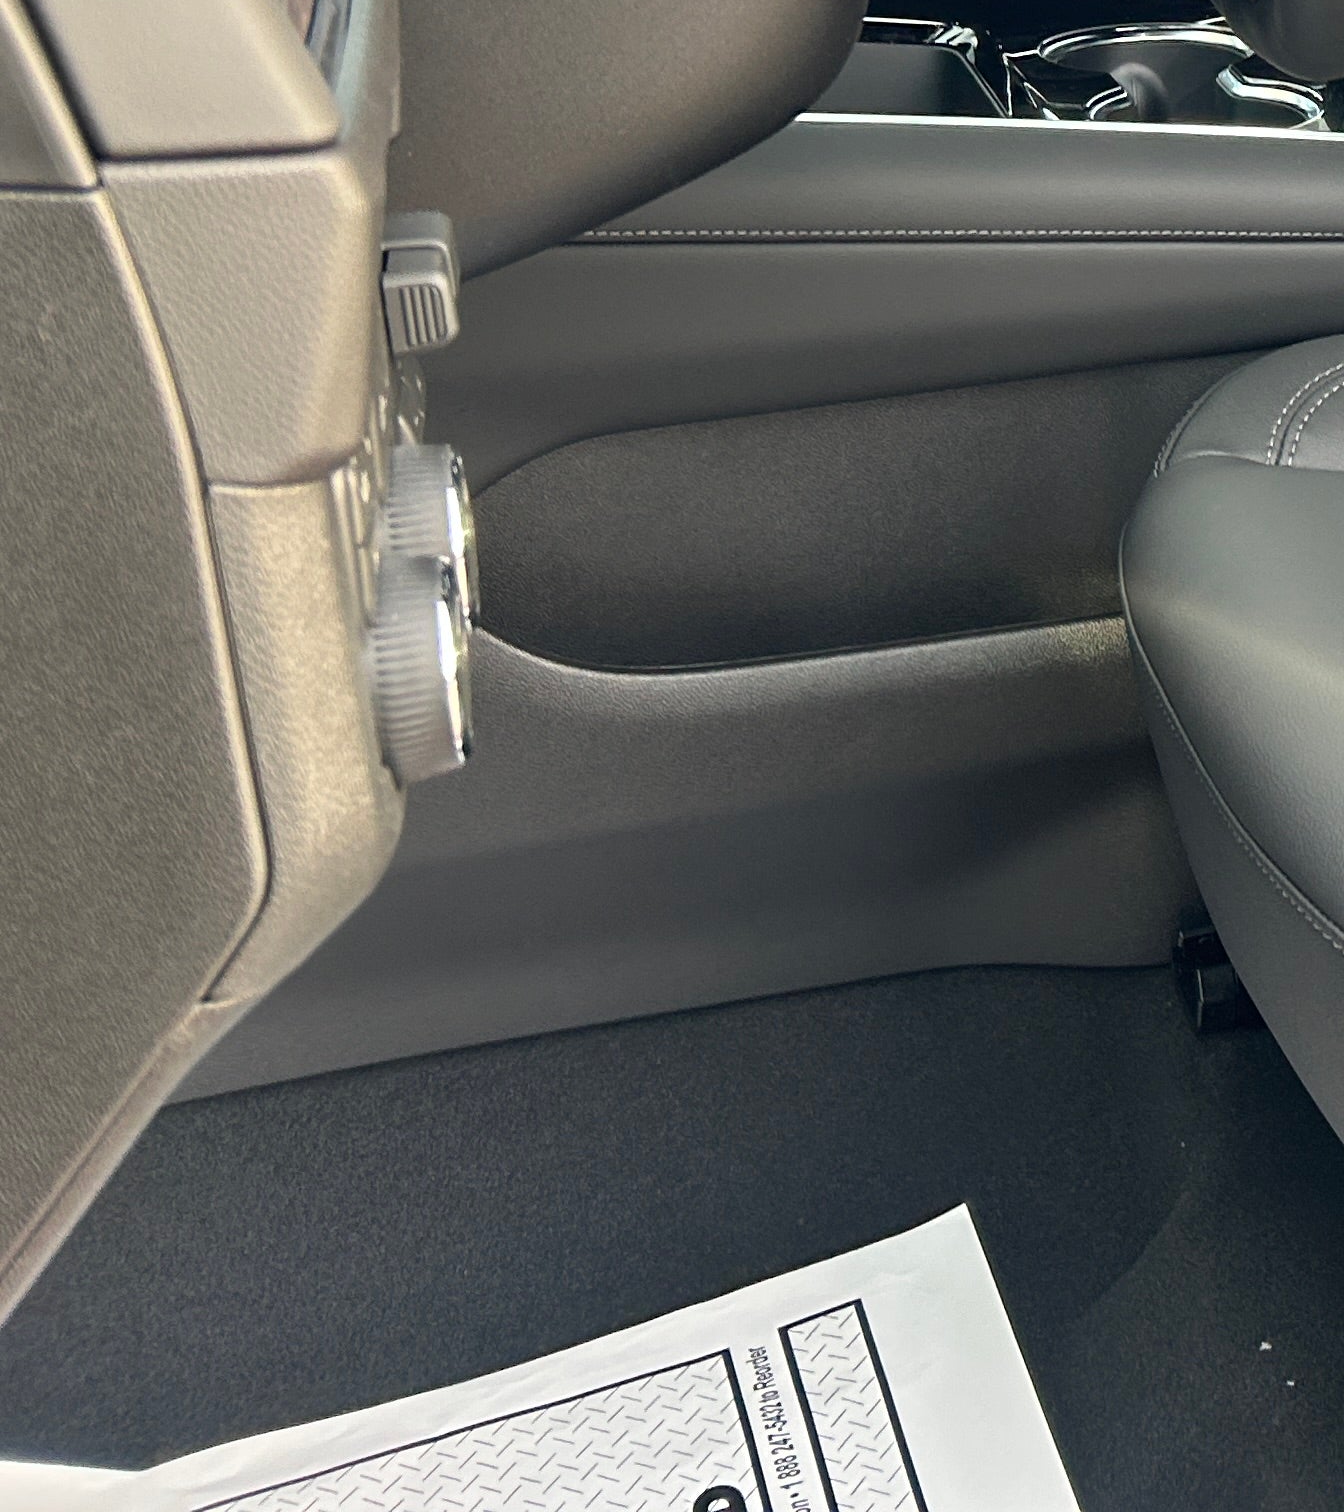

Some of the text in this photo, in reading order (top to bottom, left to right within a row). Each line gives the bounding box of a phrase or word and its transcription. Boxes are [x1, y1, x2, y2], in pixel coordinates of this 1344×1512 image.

[746, 1346, 776, 1391] Reorder
[759, 1390, 780, 1403] to
[759, 1402, 796, 1455] 247-5432
[773, 1455, 801, 1479] 888
[780, 1481, 804, 1489] 1
